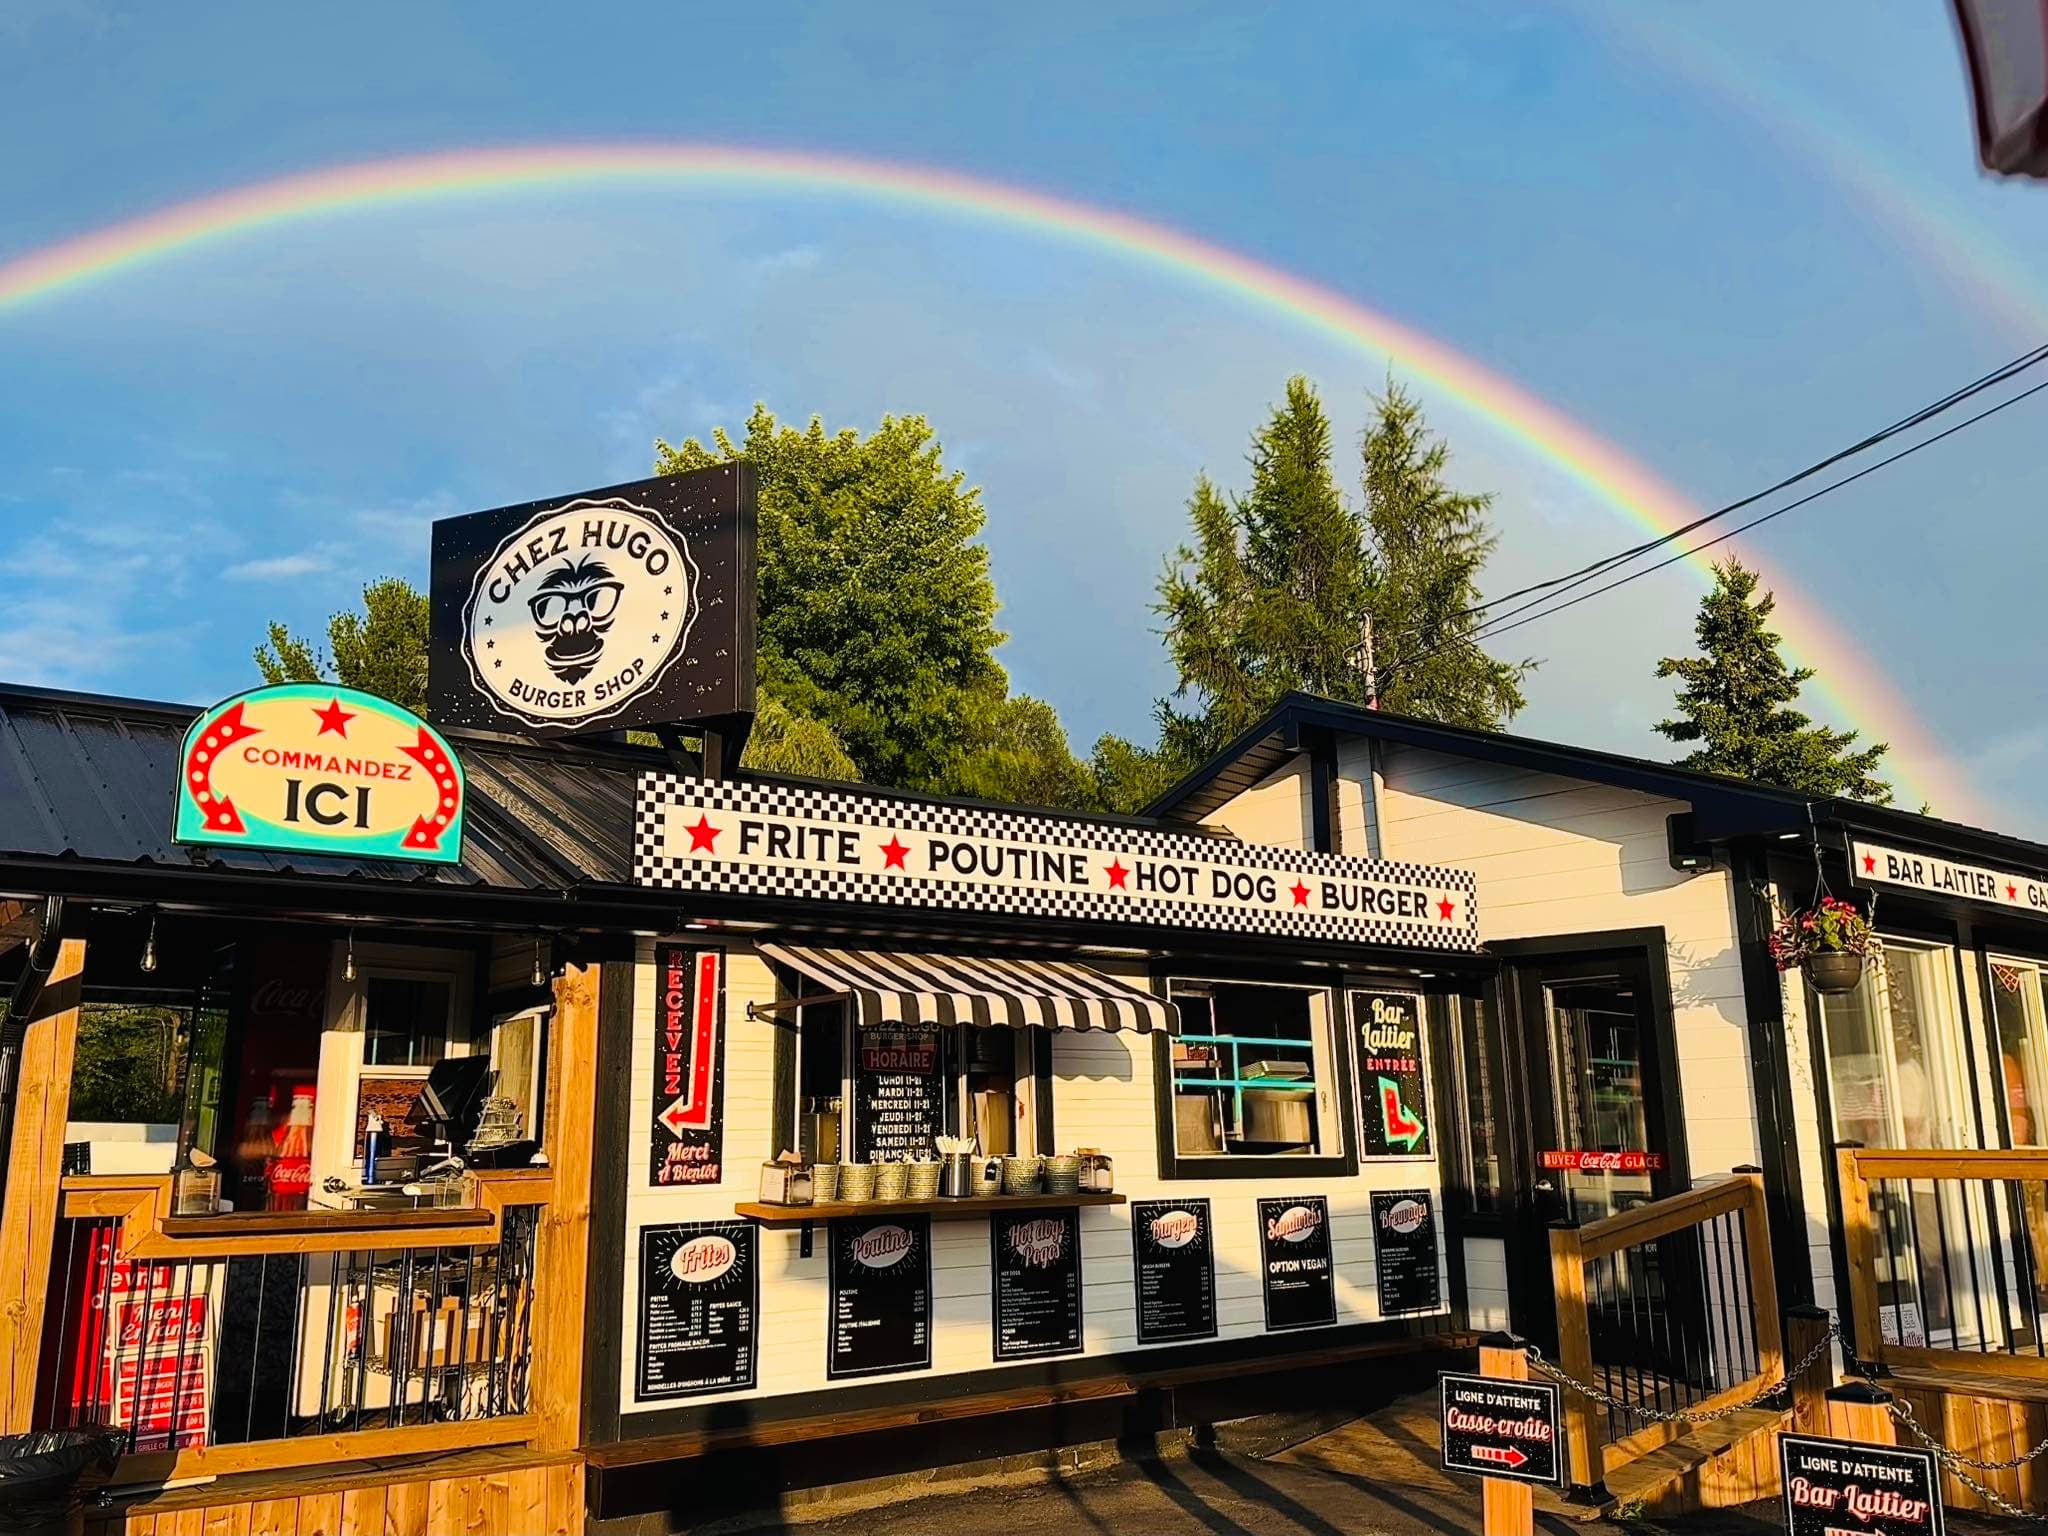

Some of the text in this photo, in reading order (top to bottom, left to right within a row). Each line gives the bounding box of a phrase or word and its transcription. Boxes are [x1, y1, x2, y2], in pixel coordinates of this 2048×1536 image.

[488, 520, 669, 604] CHEZ HUGO
[508, 658, 646, 709] BURGER SHOP
[243, 746, 412, 781] COMMANDEZ
[283, 778, 372, 829] ICI
[739, 819, 1429, 919] FRITE POUTINE HOT DOG BURGER
[1886, 853, 2048, 909] BAR LAITIER GA
[664, 950, 684, 1095] RECEVEZ
[1371, 998, 1405, 1025] Bar
[870, 1032, 905, 1041] BURGER
[1361, 1022, 1415, 1056] Laitier
[870, 1051, 930, 1068] HORAIRE
[1366, 1056, 1417, 1072] ENTRÉE
[878, 1087, 923, 1097] MARDI 11-21
[879, 1075, 922, 1086] LUNDI 11-21
[871, 1099, 930, 1110] MERCREDI 11-21
[880, 1112, 922, 1122] JEUDI 11-21
[871, 1124, 930, 1135] VENDREDI 11-21
[876, 1136, 926, 1147] SAMEDI 11-21
[667, 1142, 711, 1162] Merci
[1544, 1153, 1577, 1166] BUVEZ
[271, 1163, 314, 1184] Coca-Col
[1150, 1215, 1197, 1241] Burgers
[1380, 1203, 1427, 1229] Breuvages
[851, 1230, 913, 1261] Poutines
[1009, 1219, 1064, 1247] Hot dogs
[680, 1244, 730, 1274] Frites
[1023, 1244, 1060, 1269] Pogos
[1269, 1258, 1327, 1274] OPTION VEGAN
[1455, 1390, 1541, 1410] LIGNE D'ATTENTE
[1447, 1406, 1551, 1441] Casse-croûte
[1800, 1455, 1914, 1483] LIGNE D'ATTENTE
[1790, 1476, 1930, 1523] Bar Laitier
